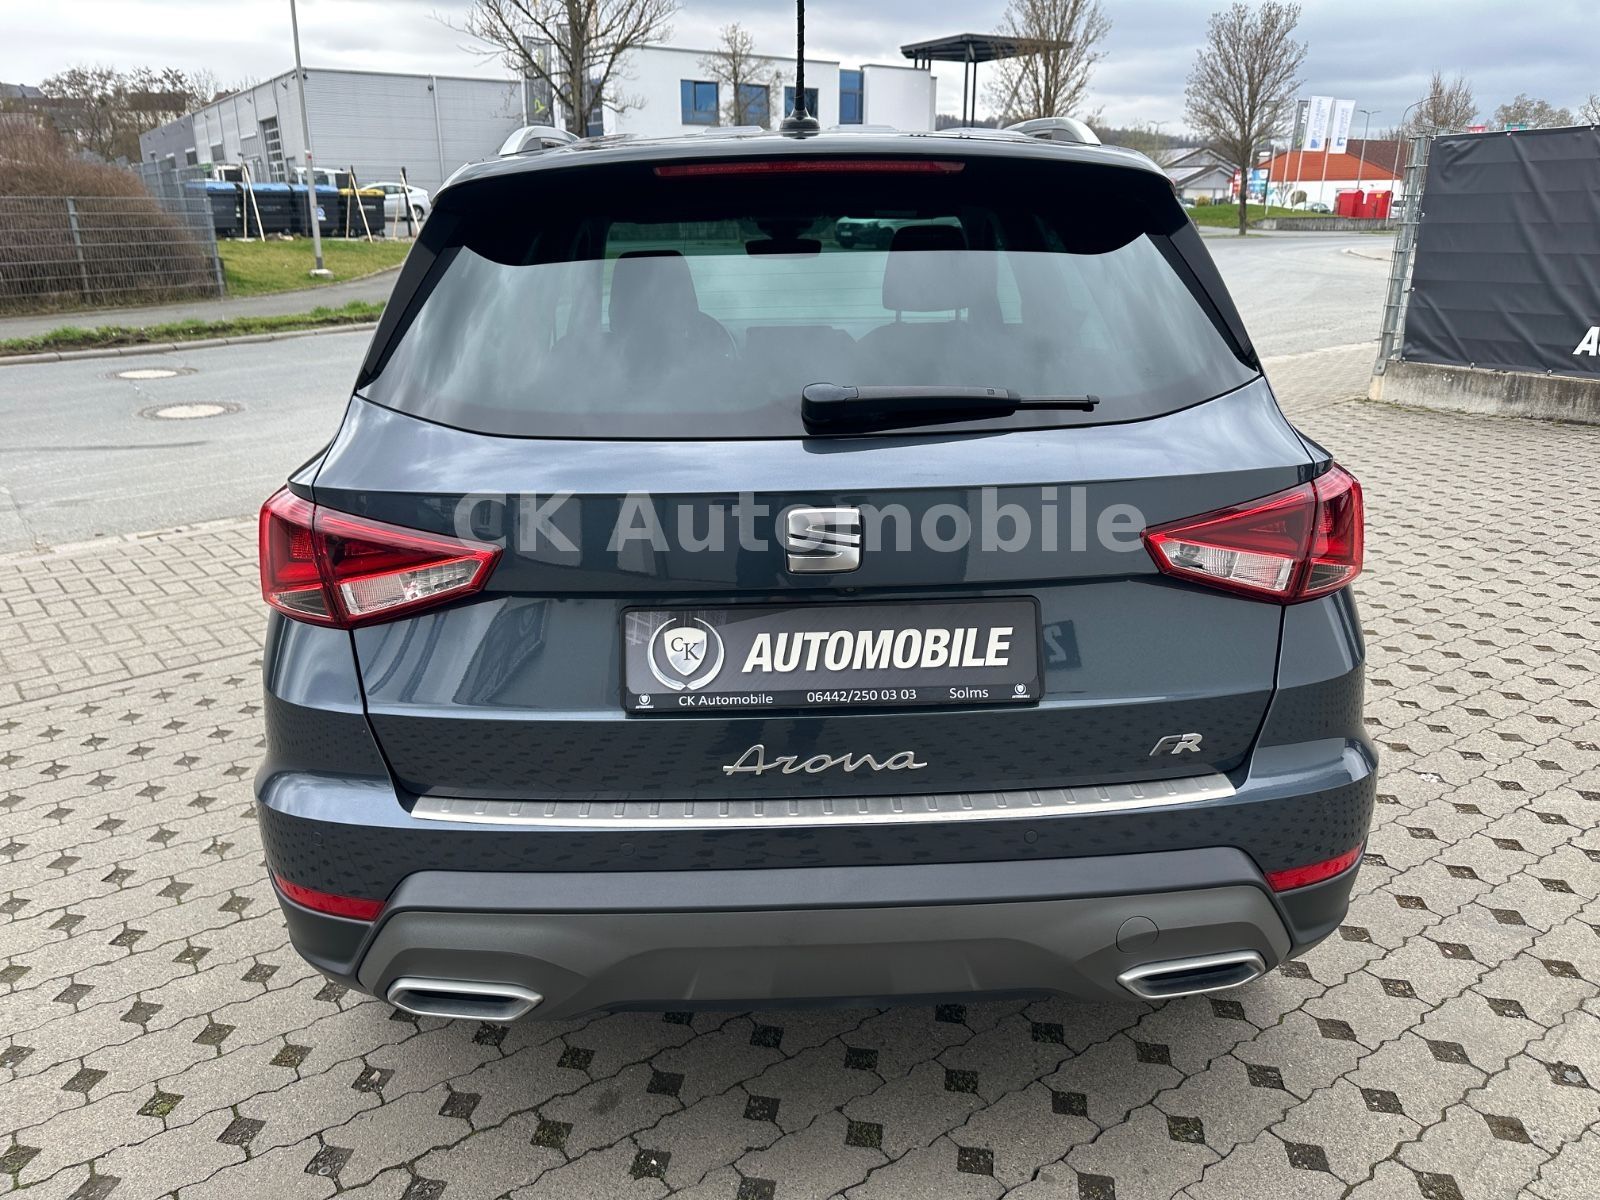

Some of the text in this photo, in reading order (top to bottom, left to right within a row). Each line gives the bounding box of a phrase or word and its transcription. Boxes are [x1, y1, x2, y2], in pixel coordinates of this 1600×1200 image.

[671, 636, 700, 661] CK
[741, 627, 1014, 673] AUTOMOBILE
[678, 687, 989, 706] CK Automobile 06442/250 03 03 Solms
[1149, 733, 1203, 757] FR
[722, 744, 928, 776] Arona
